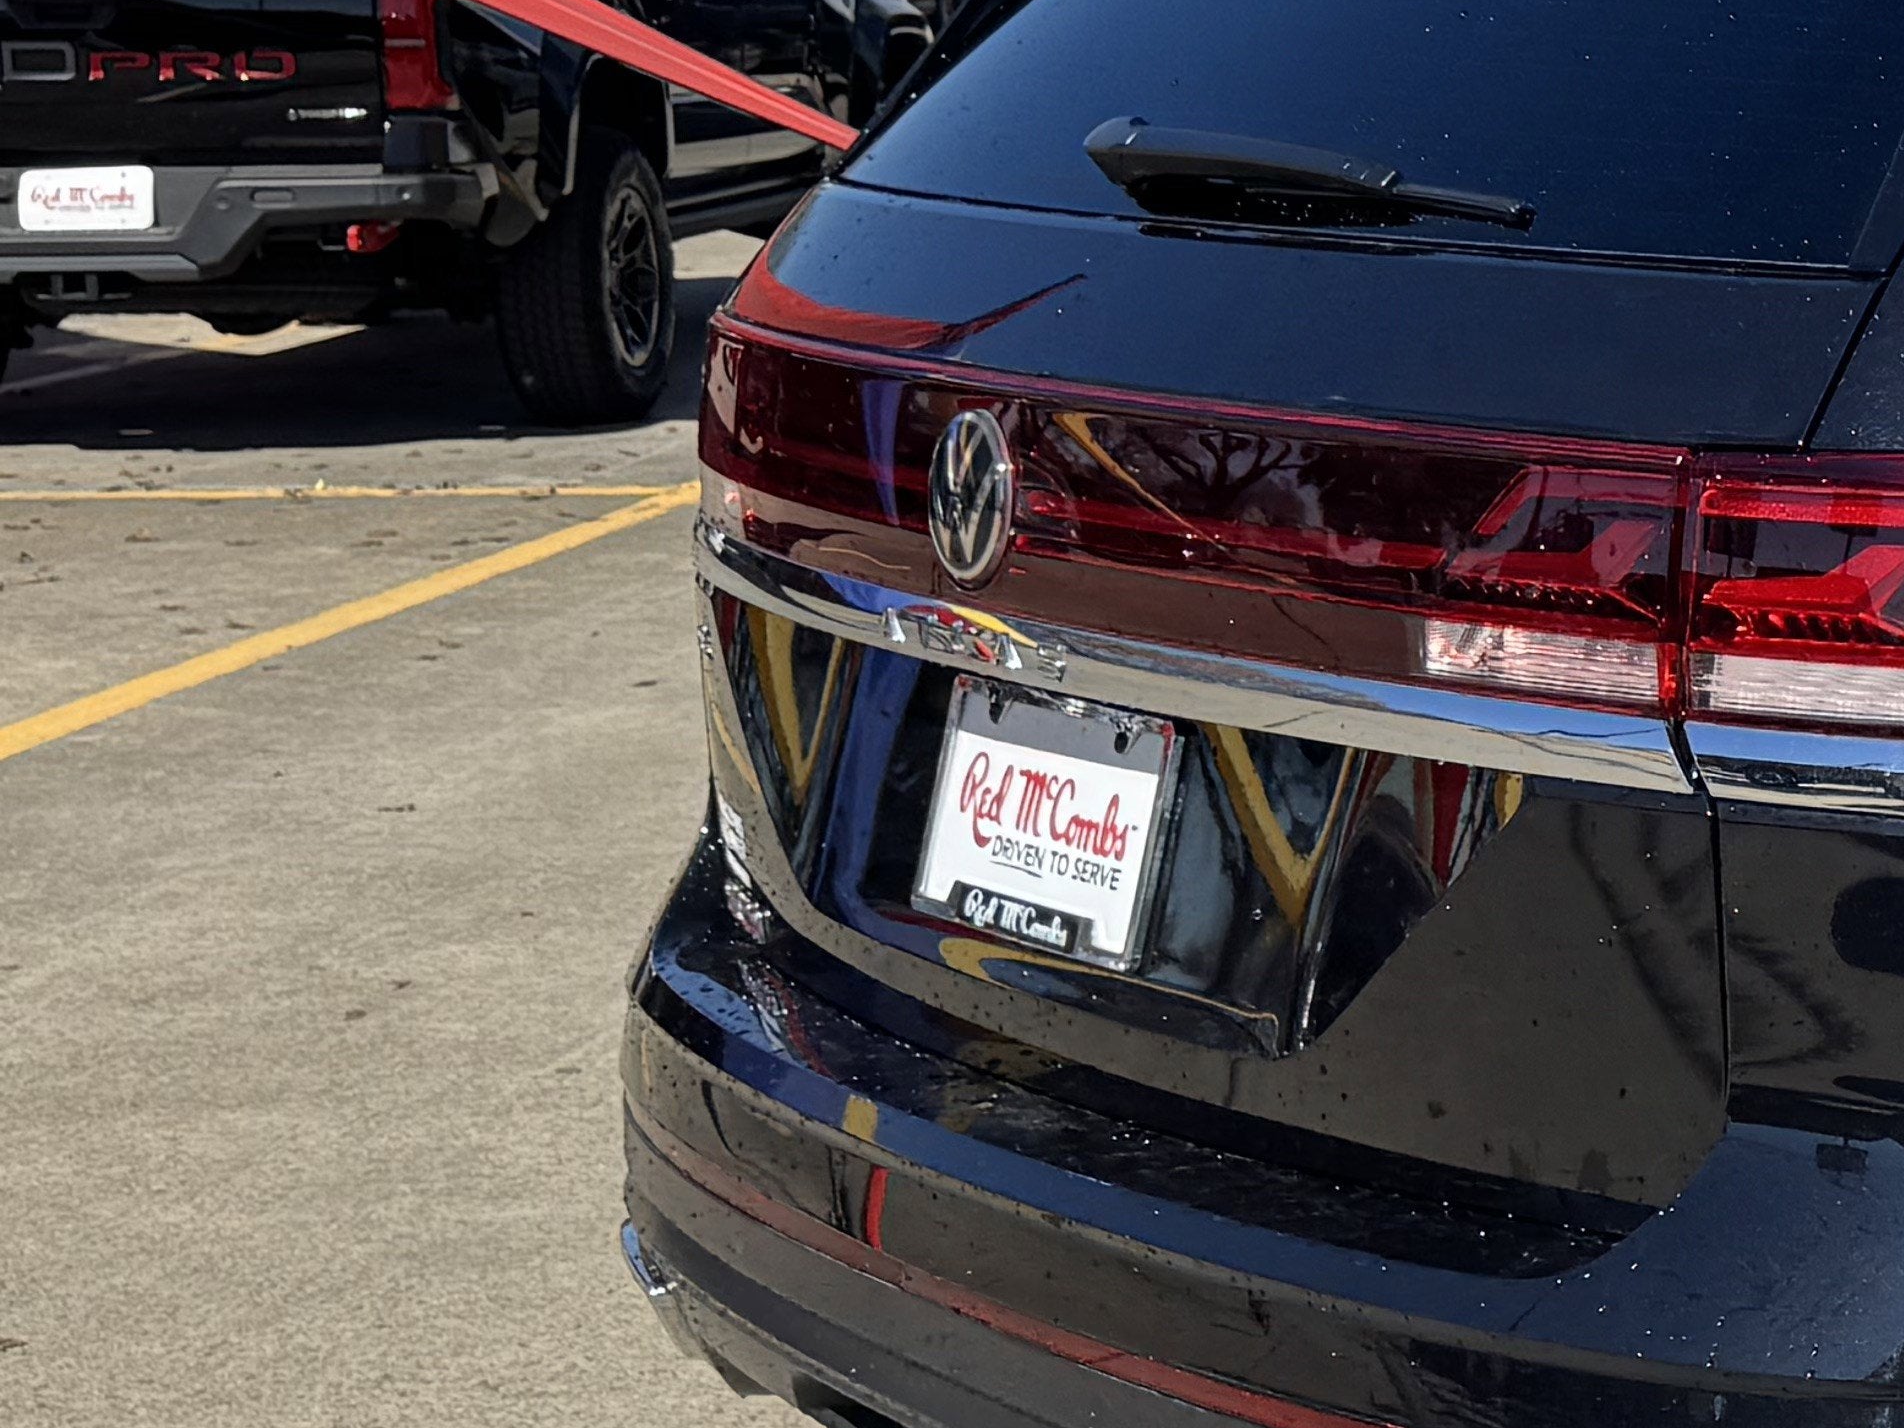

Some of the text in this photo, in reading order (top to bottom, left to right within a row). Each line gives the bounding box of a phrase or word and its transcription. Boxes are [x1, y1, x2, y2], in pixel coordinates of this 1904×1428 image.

[89, 51, 297, 81] PRO
[959, 751, 1129, 862] Red McCombs
[990, 835, 1122, 891] DRIVEN TO SERVE
